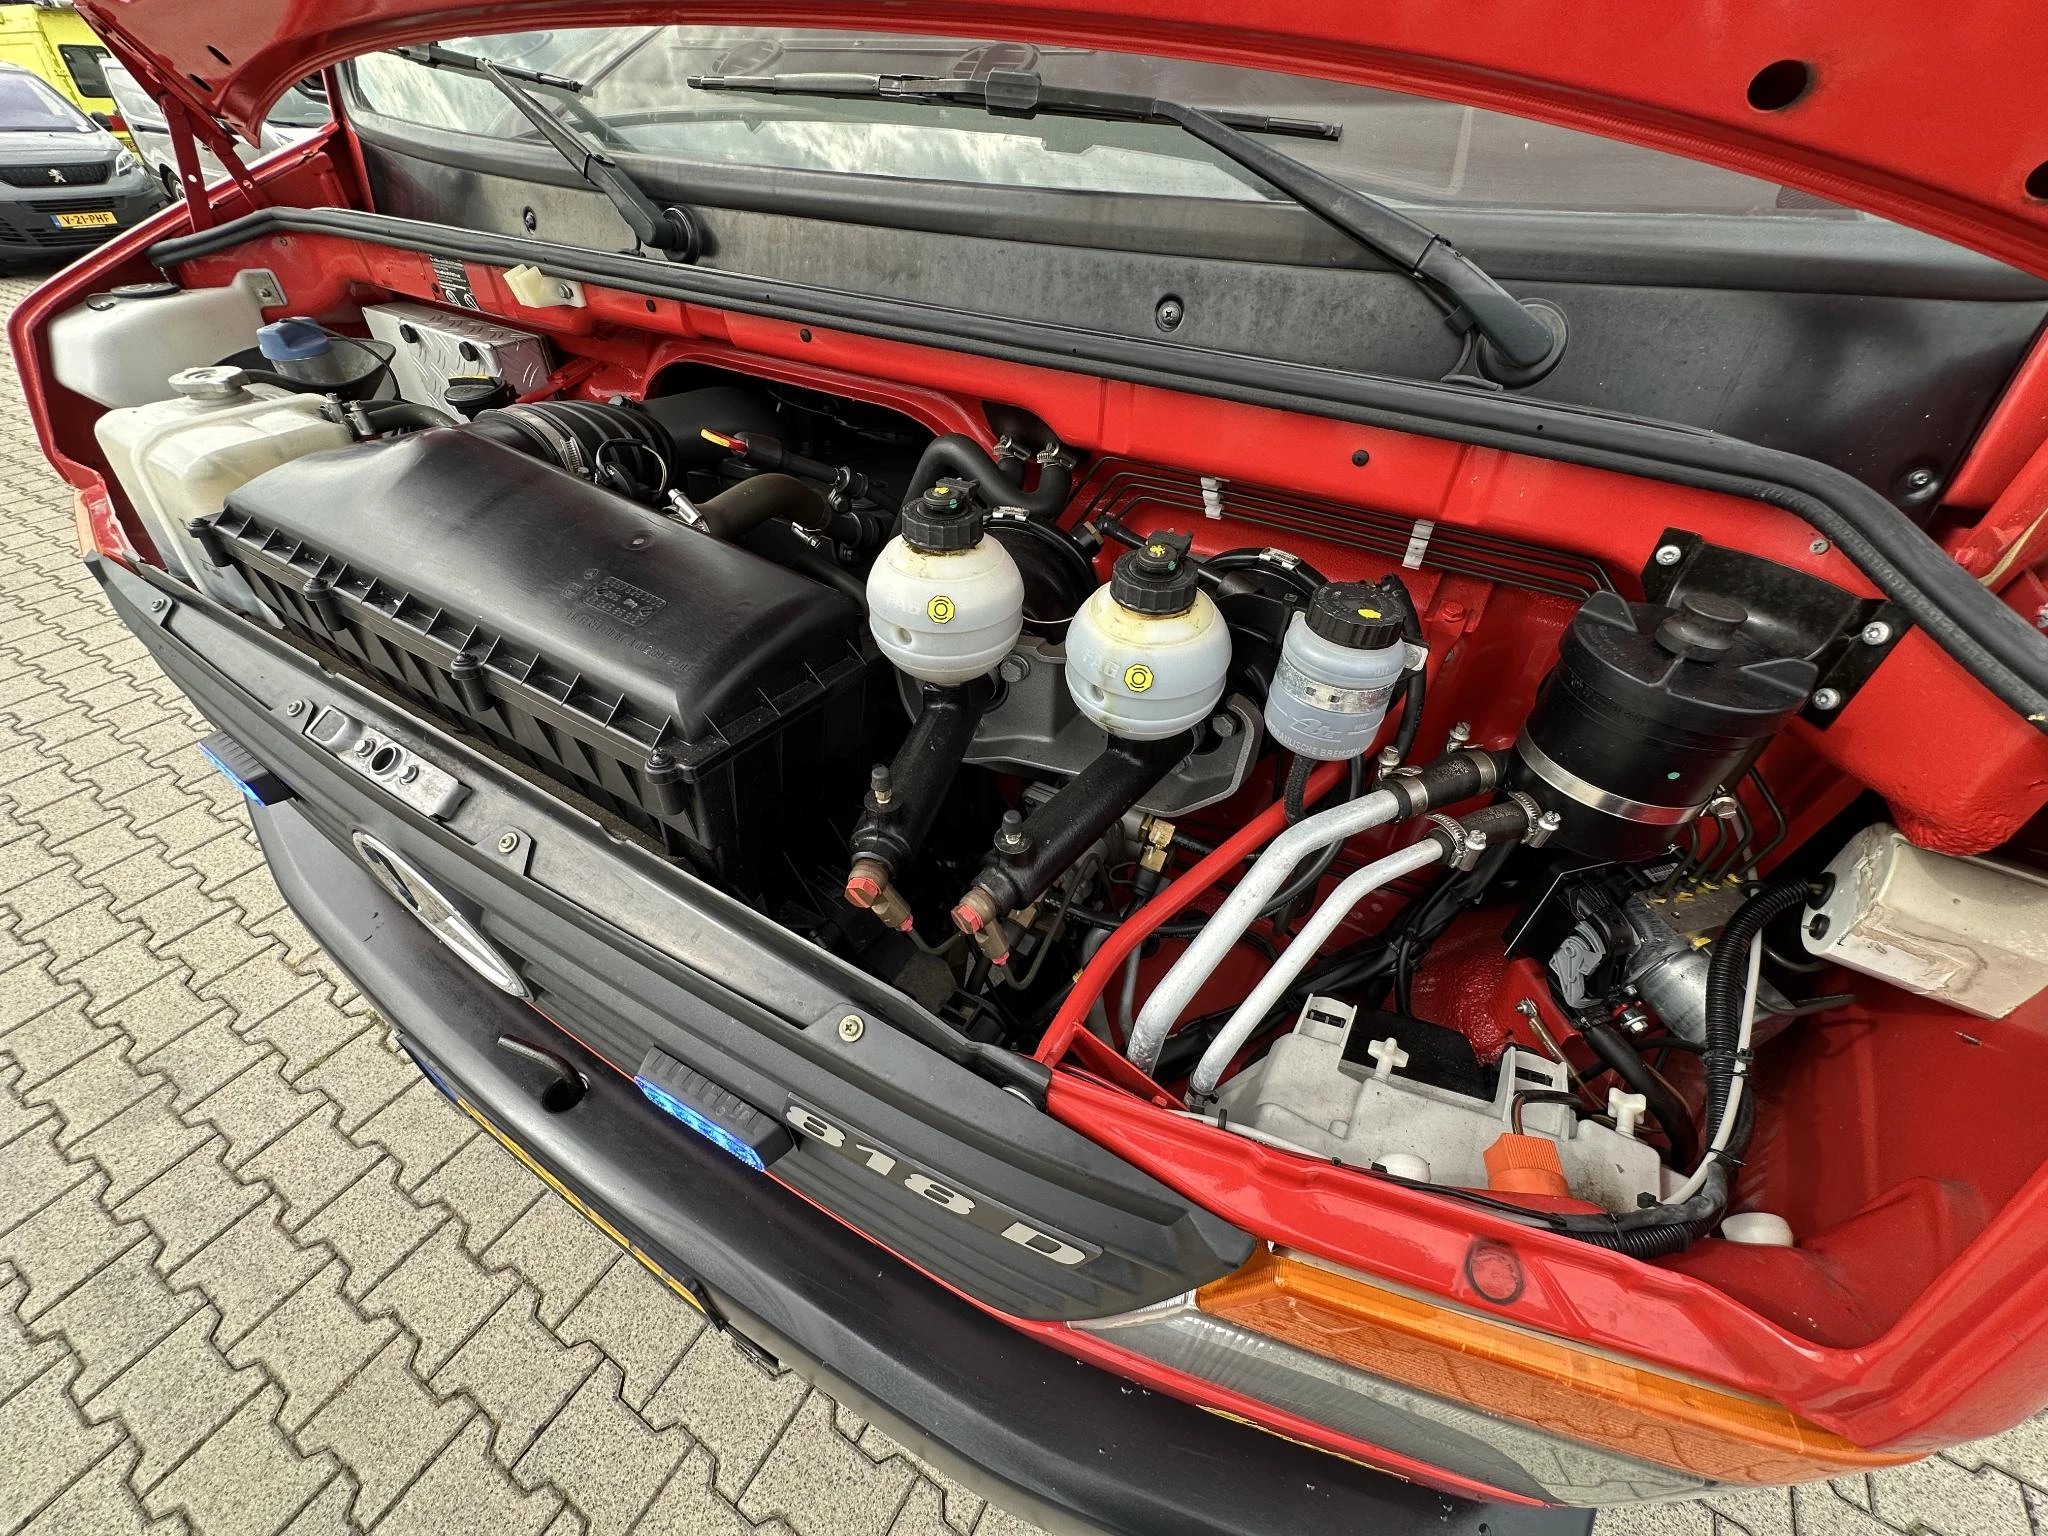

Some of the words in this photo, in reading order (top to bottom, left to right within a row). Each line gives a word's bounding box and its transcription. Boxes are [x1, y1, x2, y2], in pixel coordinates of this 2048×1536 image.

[61, 213, 110, 225] V-21-PHF
[1082, 647, 1121, 680] FAG
[785, 1105, 976, 1215] 818
[1000, 1221, 1086, 1265] D
